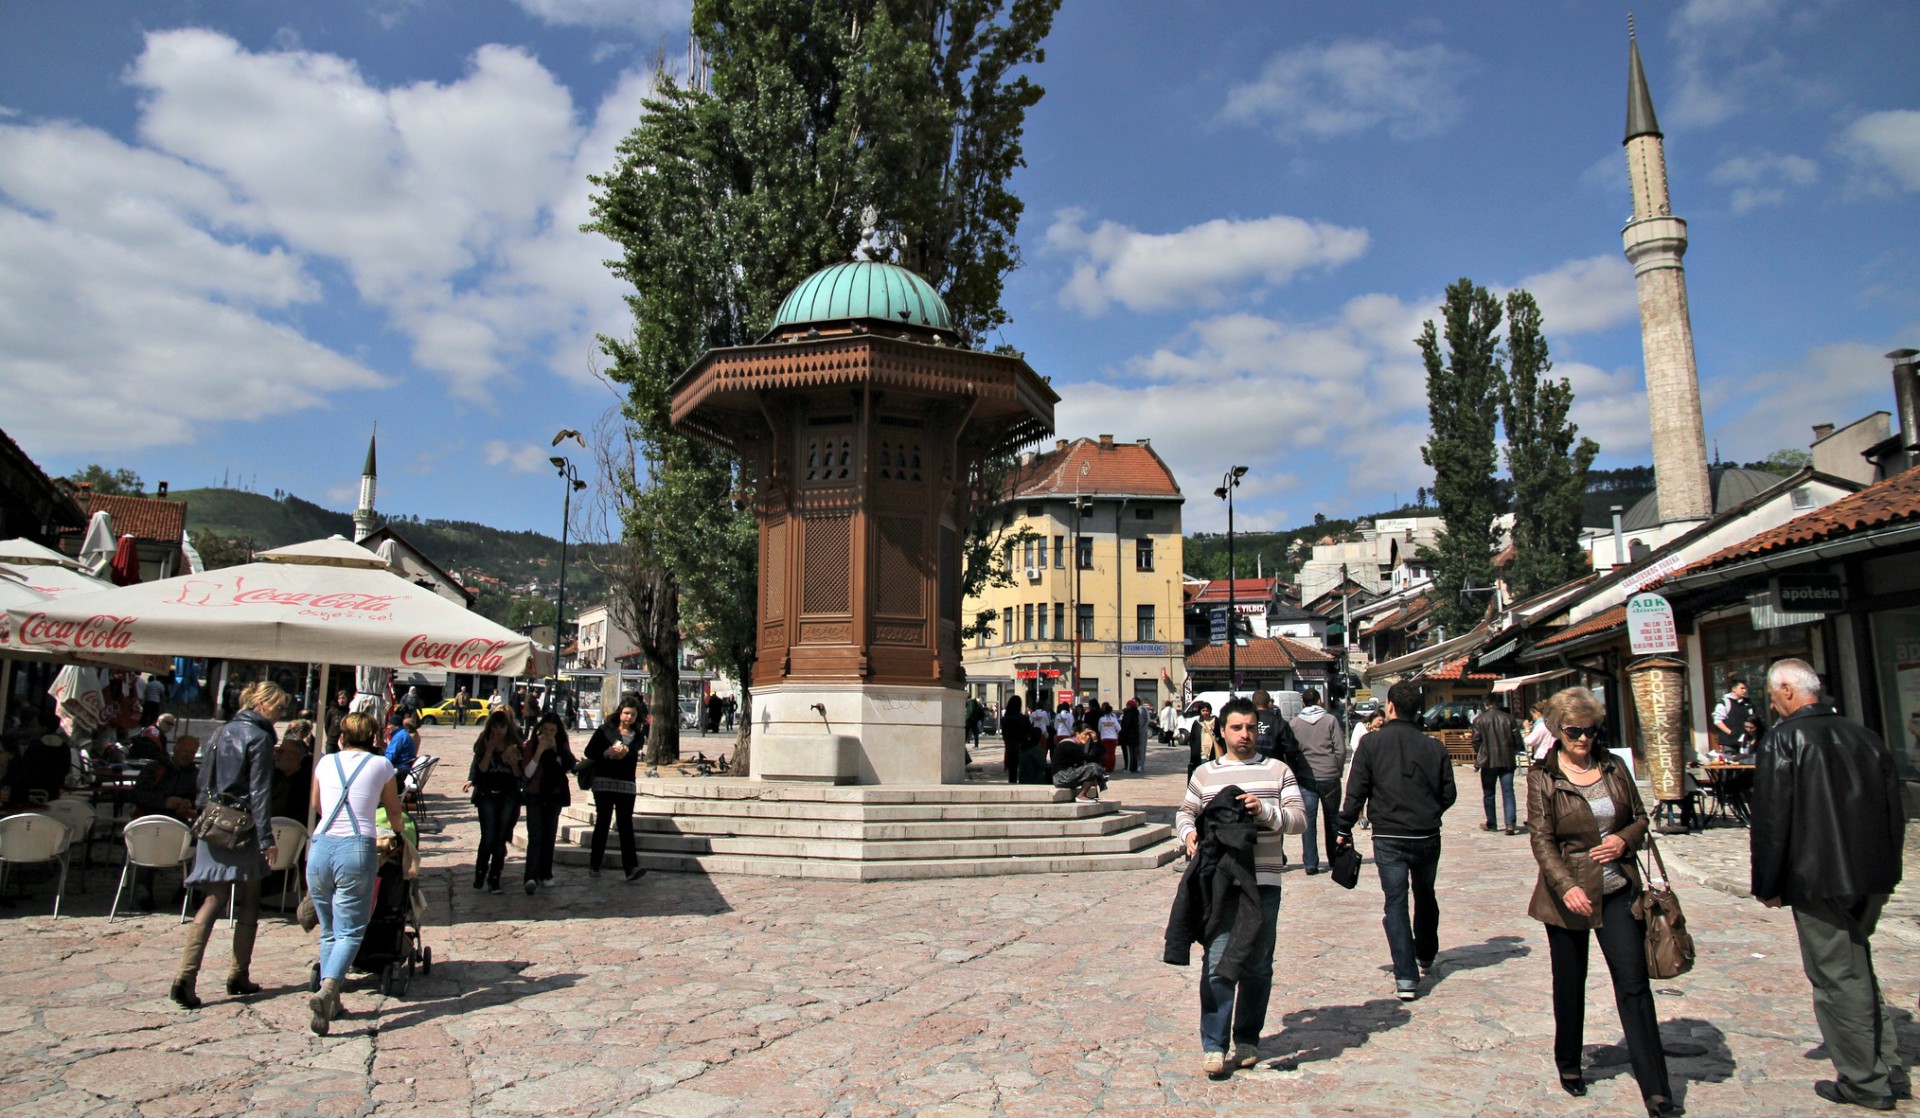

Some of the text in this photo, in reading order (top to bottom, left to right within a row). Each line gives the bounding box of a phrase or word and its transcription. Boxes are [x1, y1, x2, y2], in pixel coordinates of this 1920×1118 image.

[233, 588, 401, 611] Coca-Cola
[1632, 598, 1665, 608] ADK
[1782, 588, 1840, 602] apoteka
[19, 612, 139, 649] Coca-Cola
[400, 634, 511, 672] Coca-Cola
[1657, 732, 1675, 792] KEBAP
